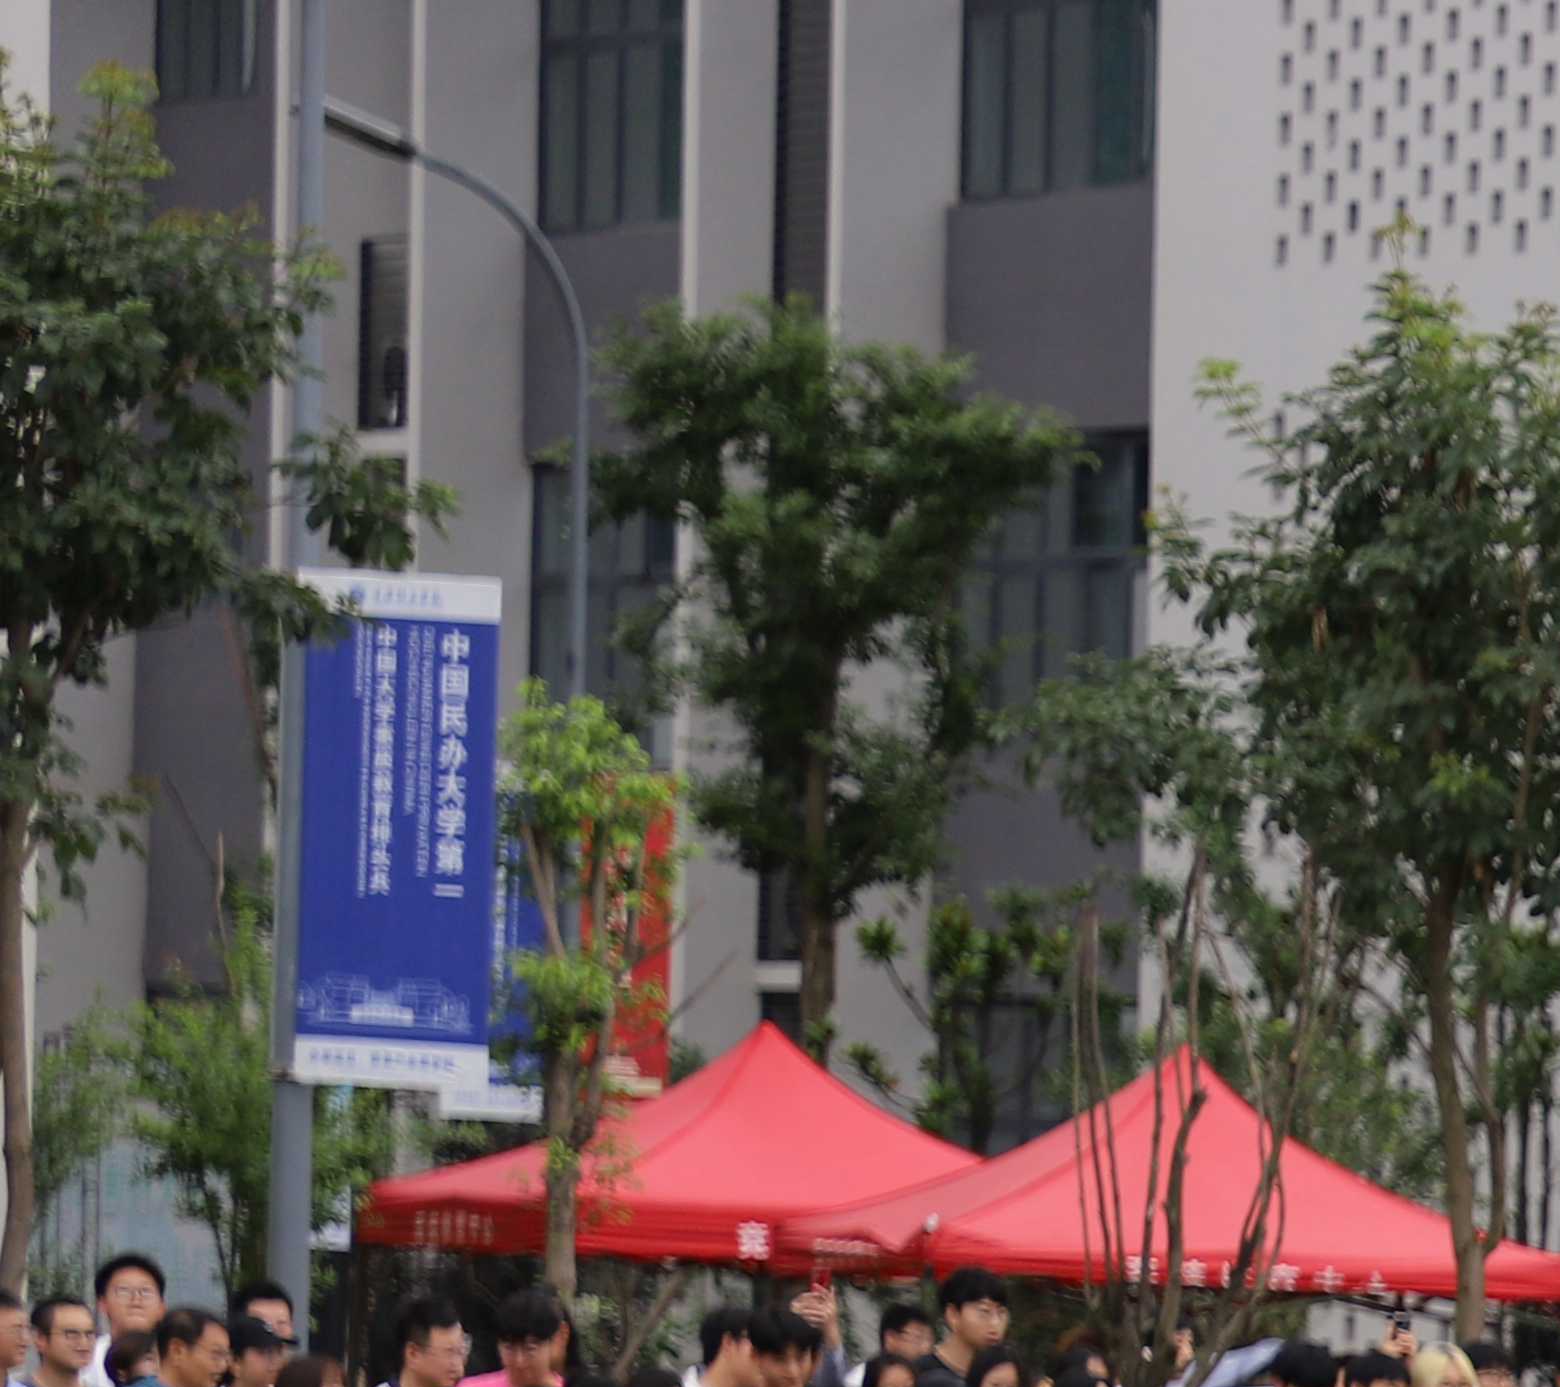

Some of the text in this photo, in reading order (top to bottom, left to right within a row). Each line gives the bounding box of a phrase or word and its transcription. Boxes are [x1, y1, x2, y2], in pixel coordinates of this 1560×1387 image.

[433, 628, 470, 899] 中国民办大学第一
